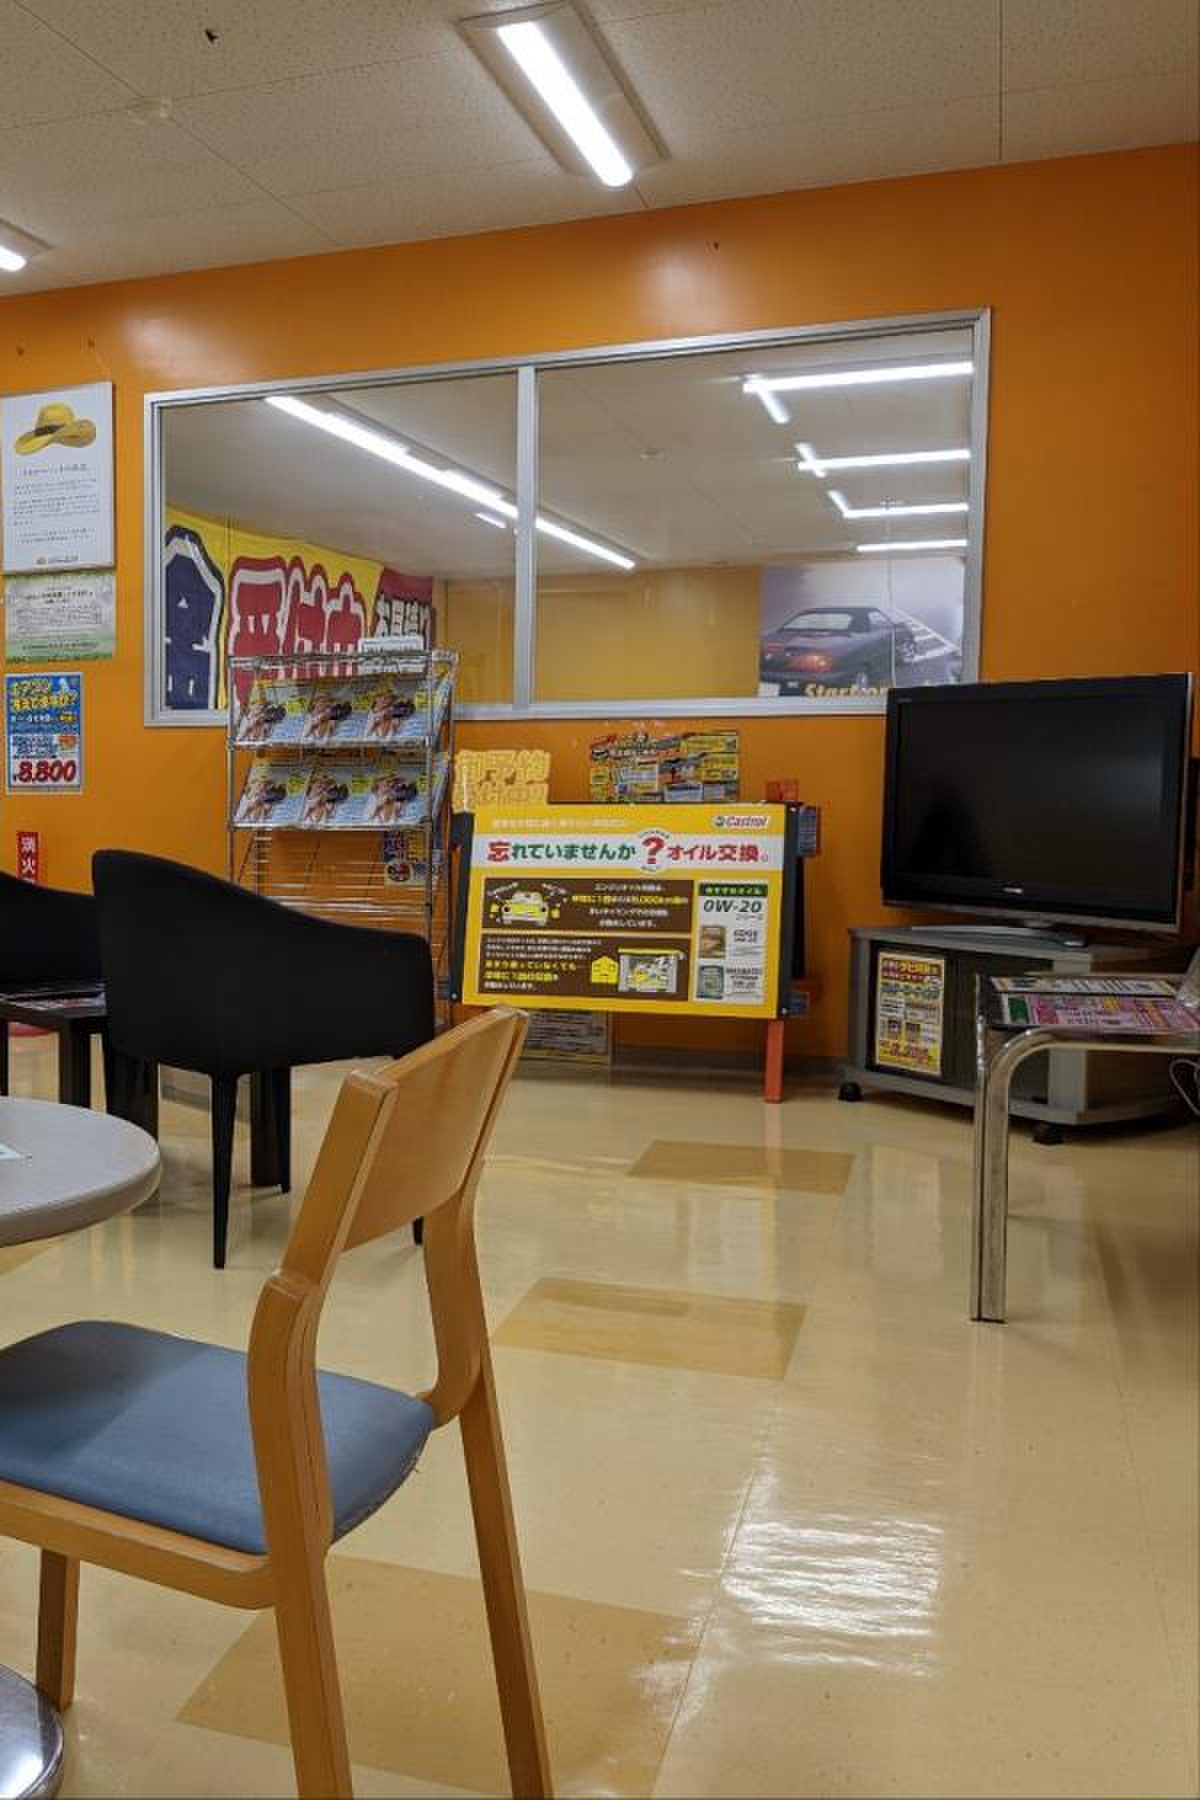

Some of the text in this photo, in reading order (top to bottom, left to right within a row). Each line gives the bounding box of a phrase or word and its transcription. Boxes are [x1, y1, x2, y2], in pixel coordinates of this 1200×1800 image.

[725, 815, 768, 828] Castrol
[21, 837, 36, 884] 消火
[703, 899, 762, 914] 0W-20
